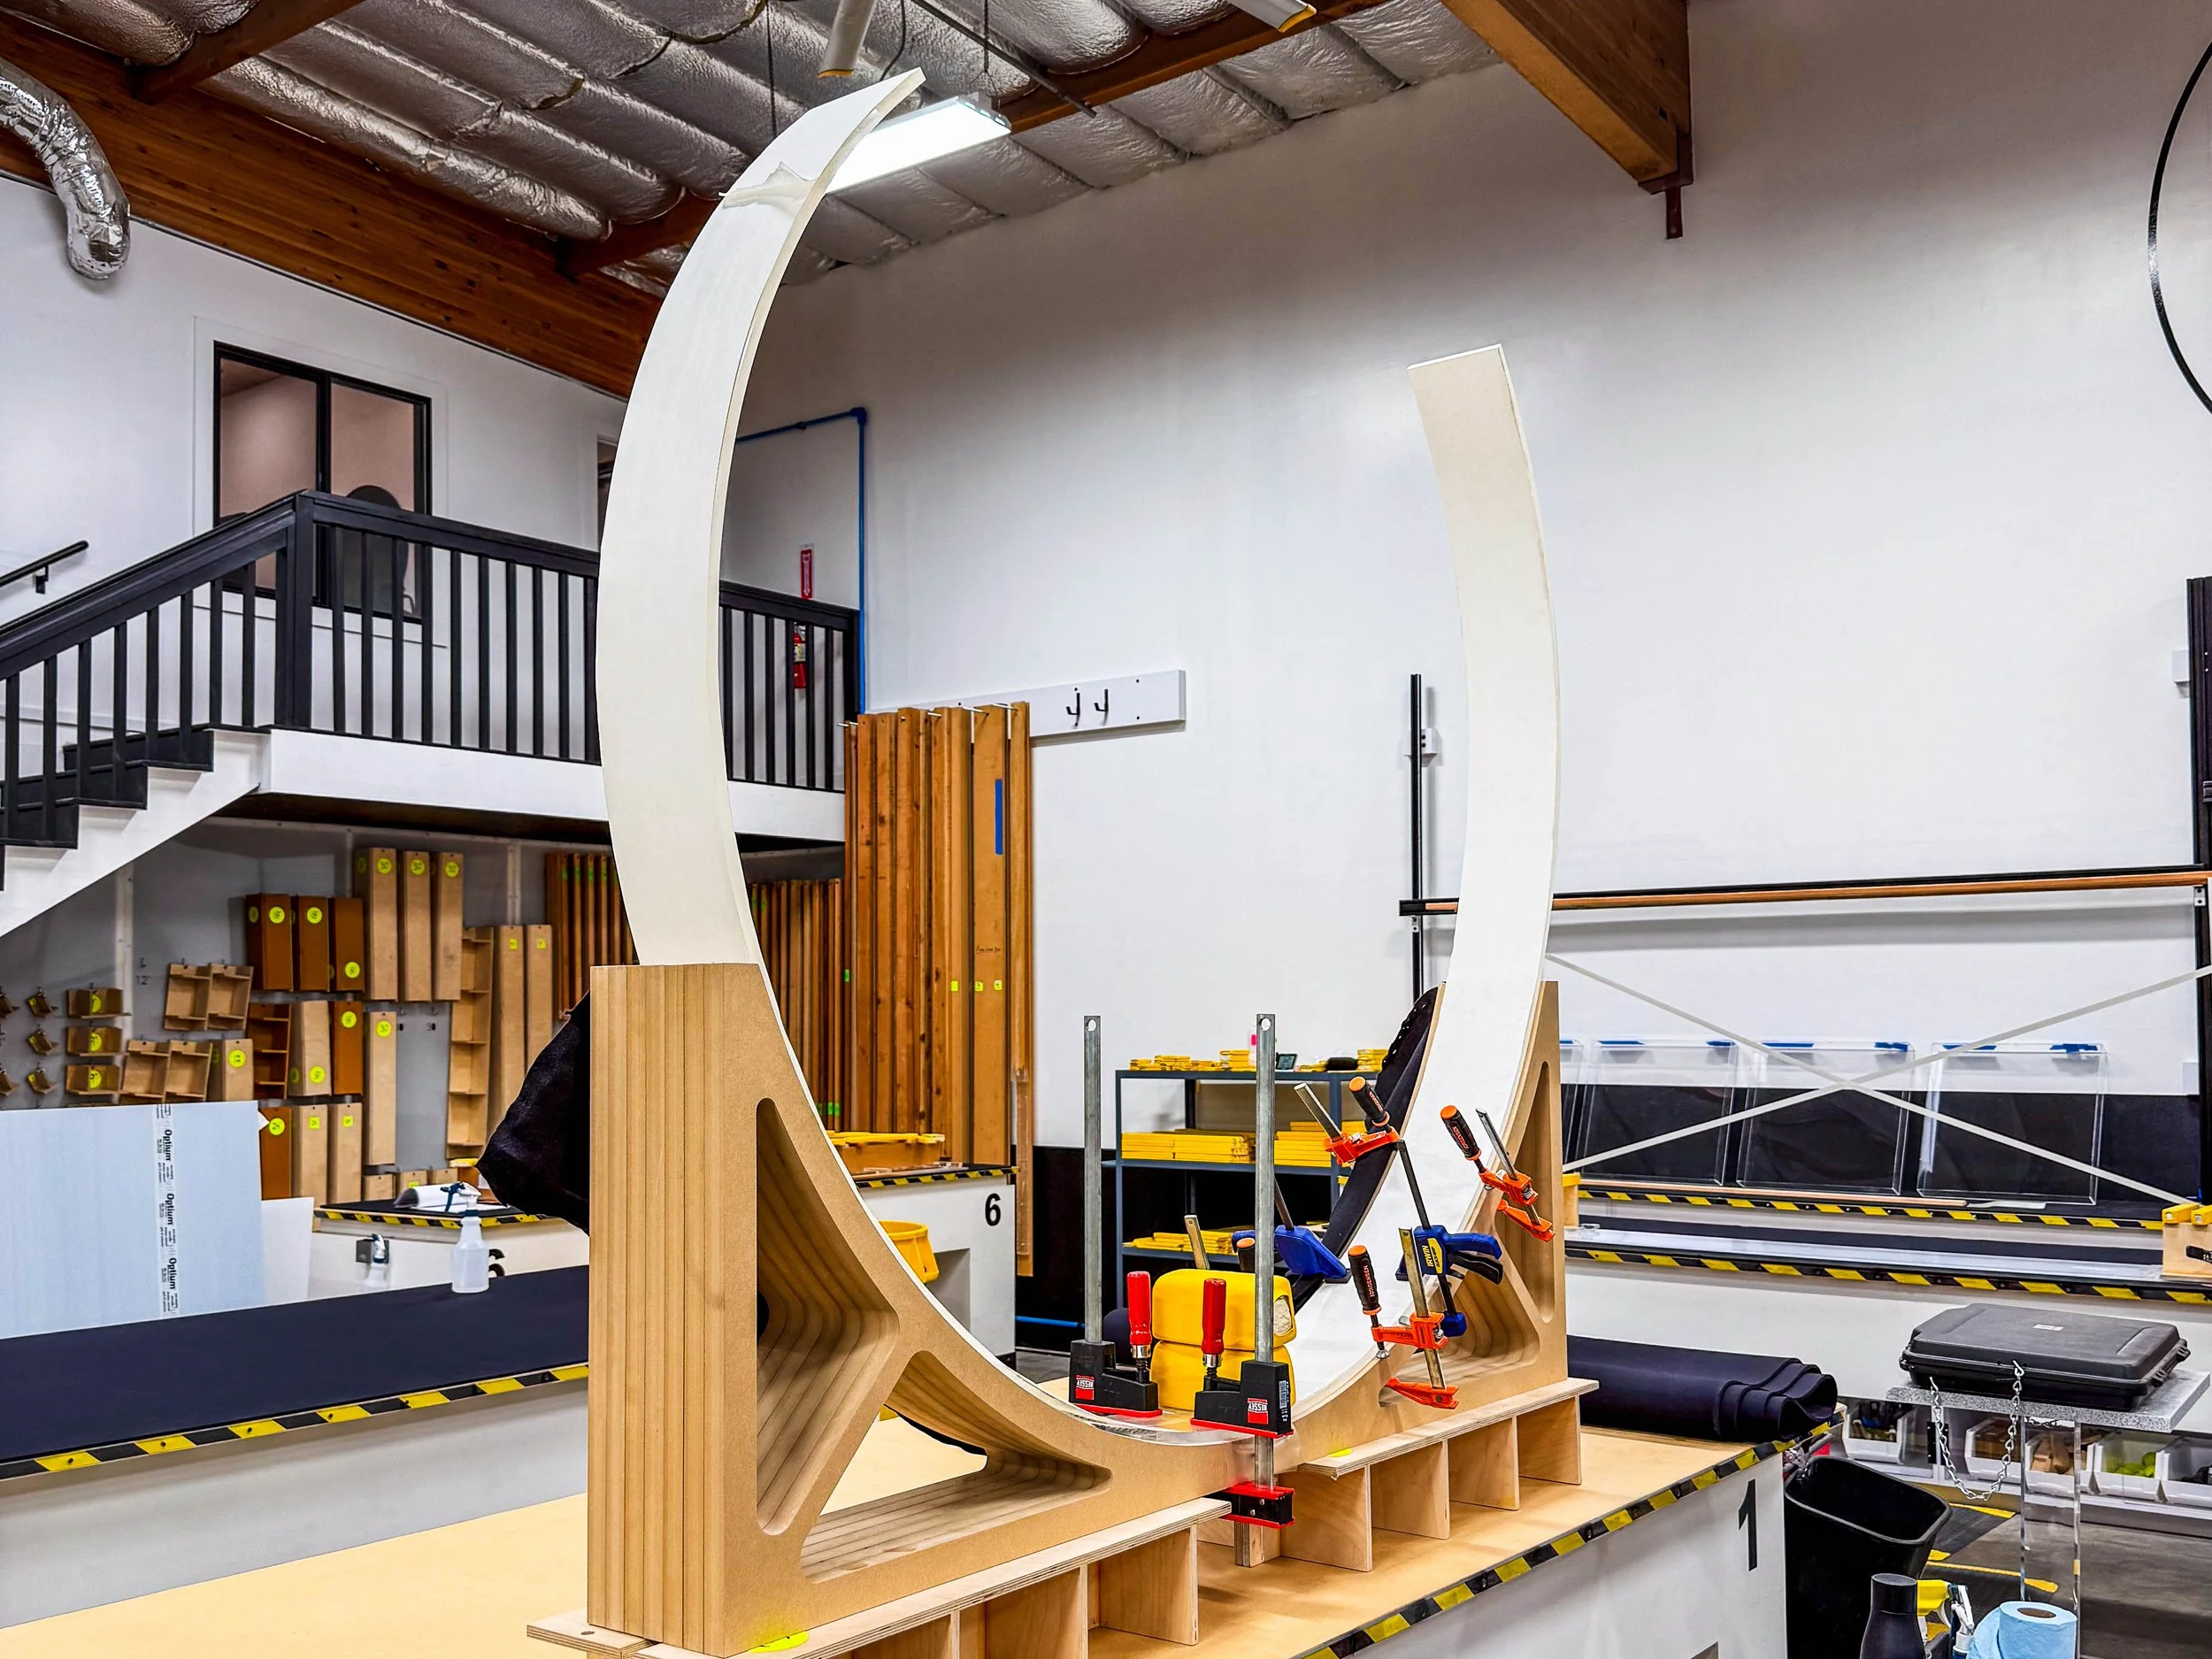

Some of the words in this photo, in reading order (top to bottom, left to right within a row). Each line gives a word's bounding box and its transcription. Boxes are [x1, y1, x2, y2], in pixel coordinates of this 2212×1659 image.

[163, 1129, 173, 1161] Optium
[165, 1194, 175, 1225] Optium
[985, 1193, 1002, 1226] 6
[1422, 1245, 1434, 1267] IRWIN
[167, 1257, 177, 1290] Optium
[1363, 1265, 1375, 1297] JORGENSEN
[1076, 1379, 1094, 1389] BESSEY
[1248, 1402, 1268, 1412] BESSEY
[1739, 1479, 1758, 1571] 1
